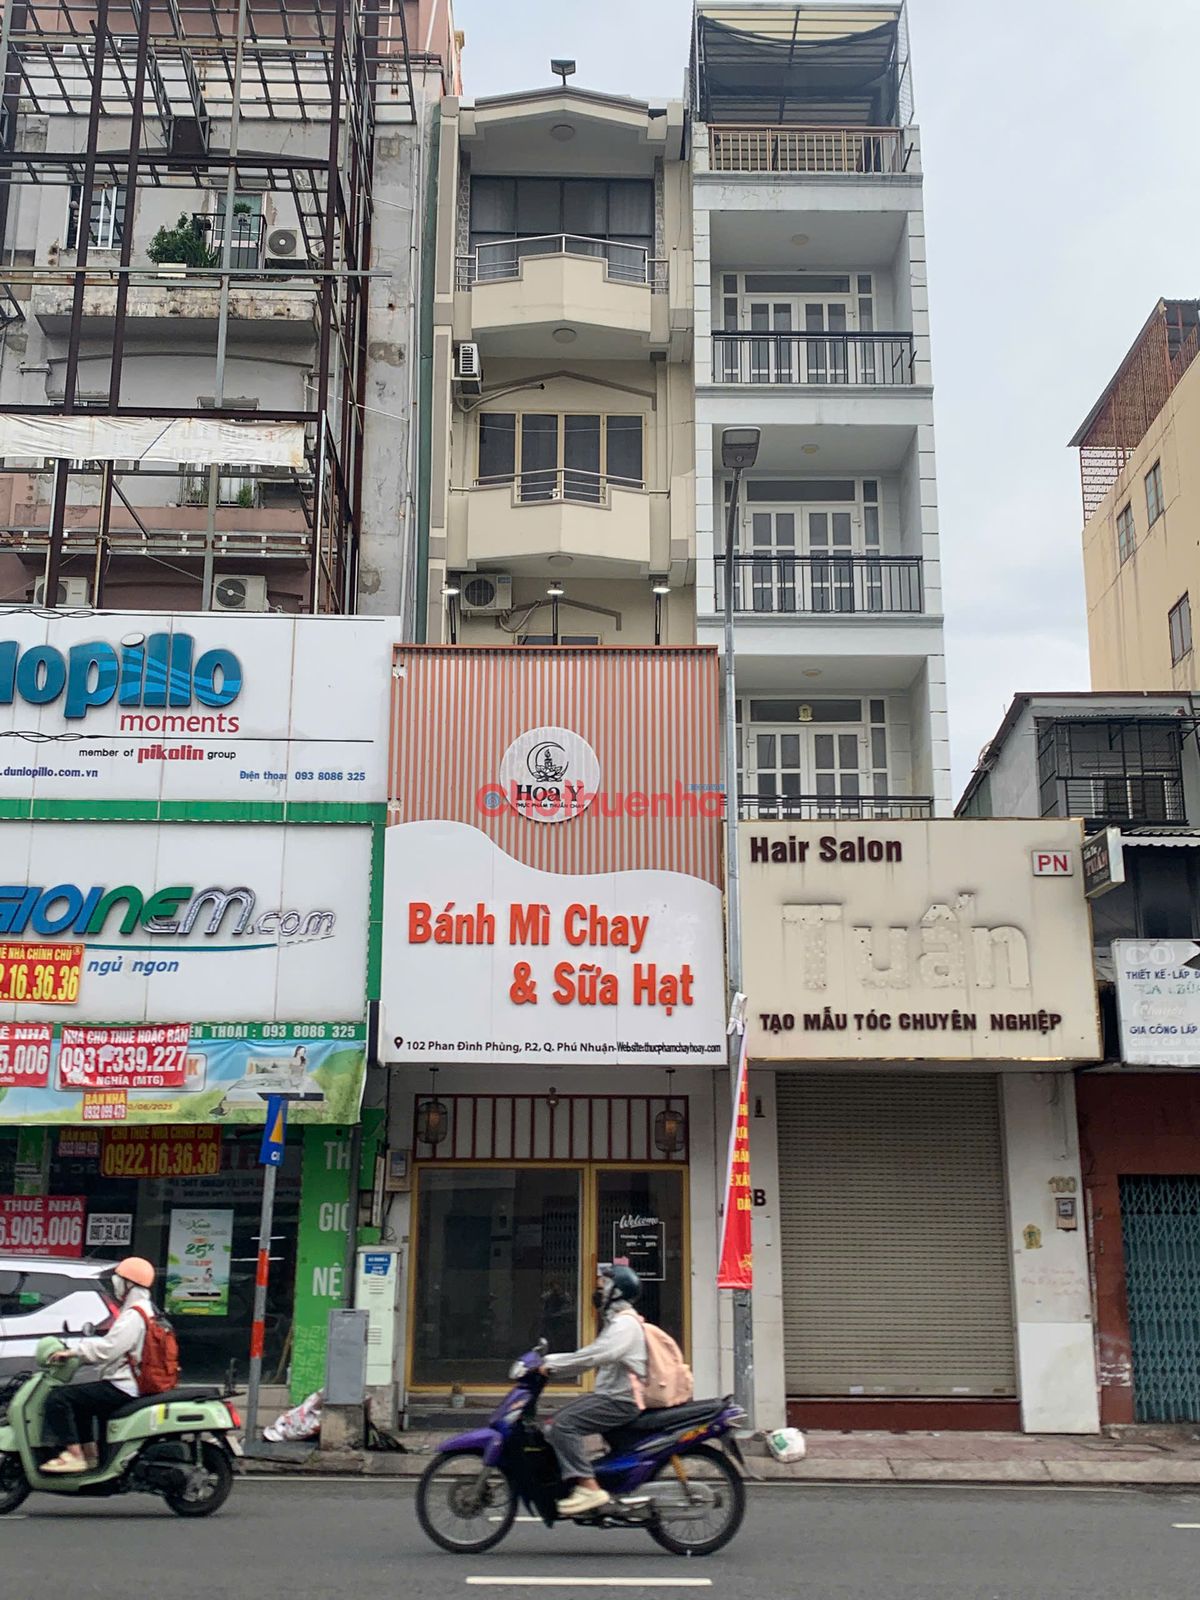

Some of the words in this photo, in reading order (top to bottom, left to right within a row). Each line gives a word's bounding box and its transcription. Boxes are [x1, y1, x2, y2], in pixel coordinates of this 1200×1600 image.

[120, 713, 239, 733] moments
[79, 748, 119, 757] member
[123, 748, 134, 757] of
[207, 749, 236, 760] group
[295, 771, 314, 781] 093
[318, 771, 343, 781] 8086
[347, 772, 366, 781] 325
[516, 784, 561, 802] Hoa
[565, 785, 584, 802] Y
[750, 835, 810, 863] Hair
[819, 836, 902, 863] Salon
[1038, 855, 1067, 872] PN
[408, 902, 496, 946] Bánh
[509, 903, 551, 946] Mì
[564, 903, 650, 954] Chay
[8, 945, 25, 961] NHÀ
[87, 955, 122, 976] ngủ
[131, 960, 179, 977] ngon
[1126, 967, 1151, 979] THIẾT
[509, 961, 538, 1006] &
[552, 961, 618, 1006] Sữa
[633, 963, 695, 1017] Hạt
[759, 1013, 796, 1035] TẠO
[804, 1006, 848, 1031] MẪU
[854, 1009, 892, 1031] TÓC
[899, 1009, 977, 1031] CHUYÊN
[991, 1009, 1063, 1035] NGHIỆP
[1129, 1026, 1146, 1035] GIA
[1149, 1023, 1178, 1035] CÔNG
[15, 1026, 50, 1041] NHÀ
[87, 1030, 108, 1045] CHO
[110, 1028, 136, 1044] THUÊ
[167, 1025, 189, 1043] BÁN
[211, 1025, 248, 1039] THOẠI
[262, 1025, 286, 1038] 093
[293, 1025, 325, 1038] 8086
[332, 1026, 355, 1038] 325
[407, 1041, 426, 1051] 102
[428, 1041, 455, 1051] Phan
[457, 1041, 483, 1051] Đình
[485, 1042, 522, 1054] Phùng,
[543, 1042, 555, 1053] Q.
[557, 1042, 577, 1052] Phú
[61, 1042, 187, 1073] 0931.339.227
[132, 1074, 164, 1087] (MTG)
[105, 1141, 218, 1176] 0922.16.36.36
[4, 1197, 43, 1213] THUÊ
[48, 1197, 83, 1213] NHÀ
